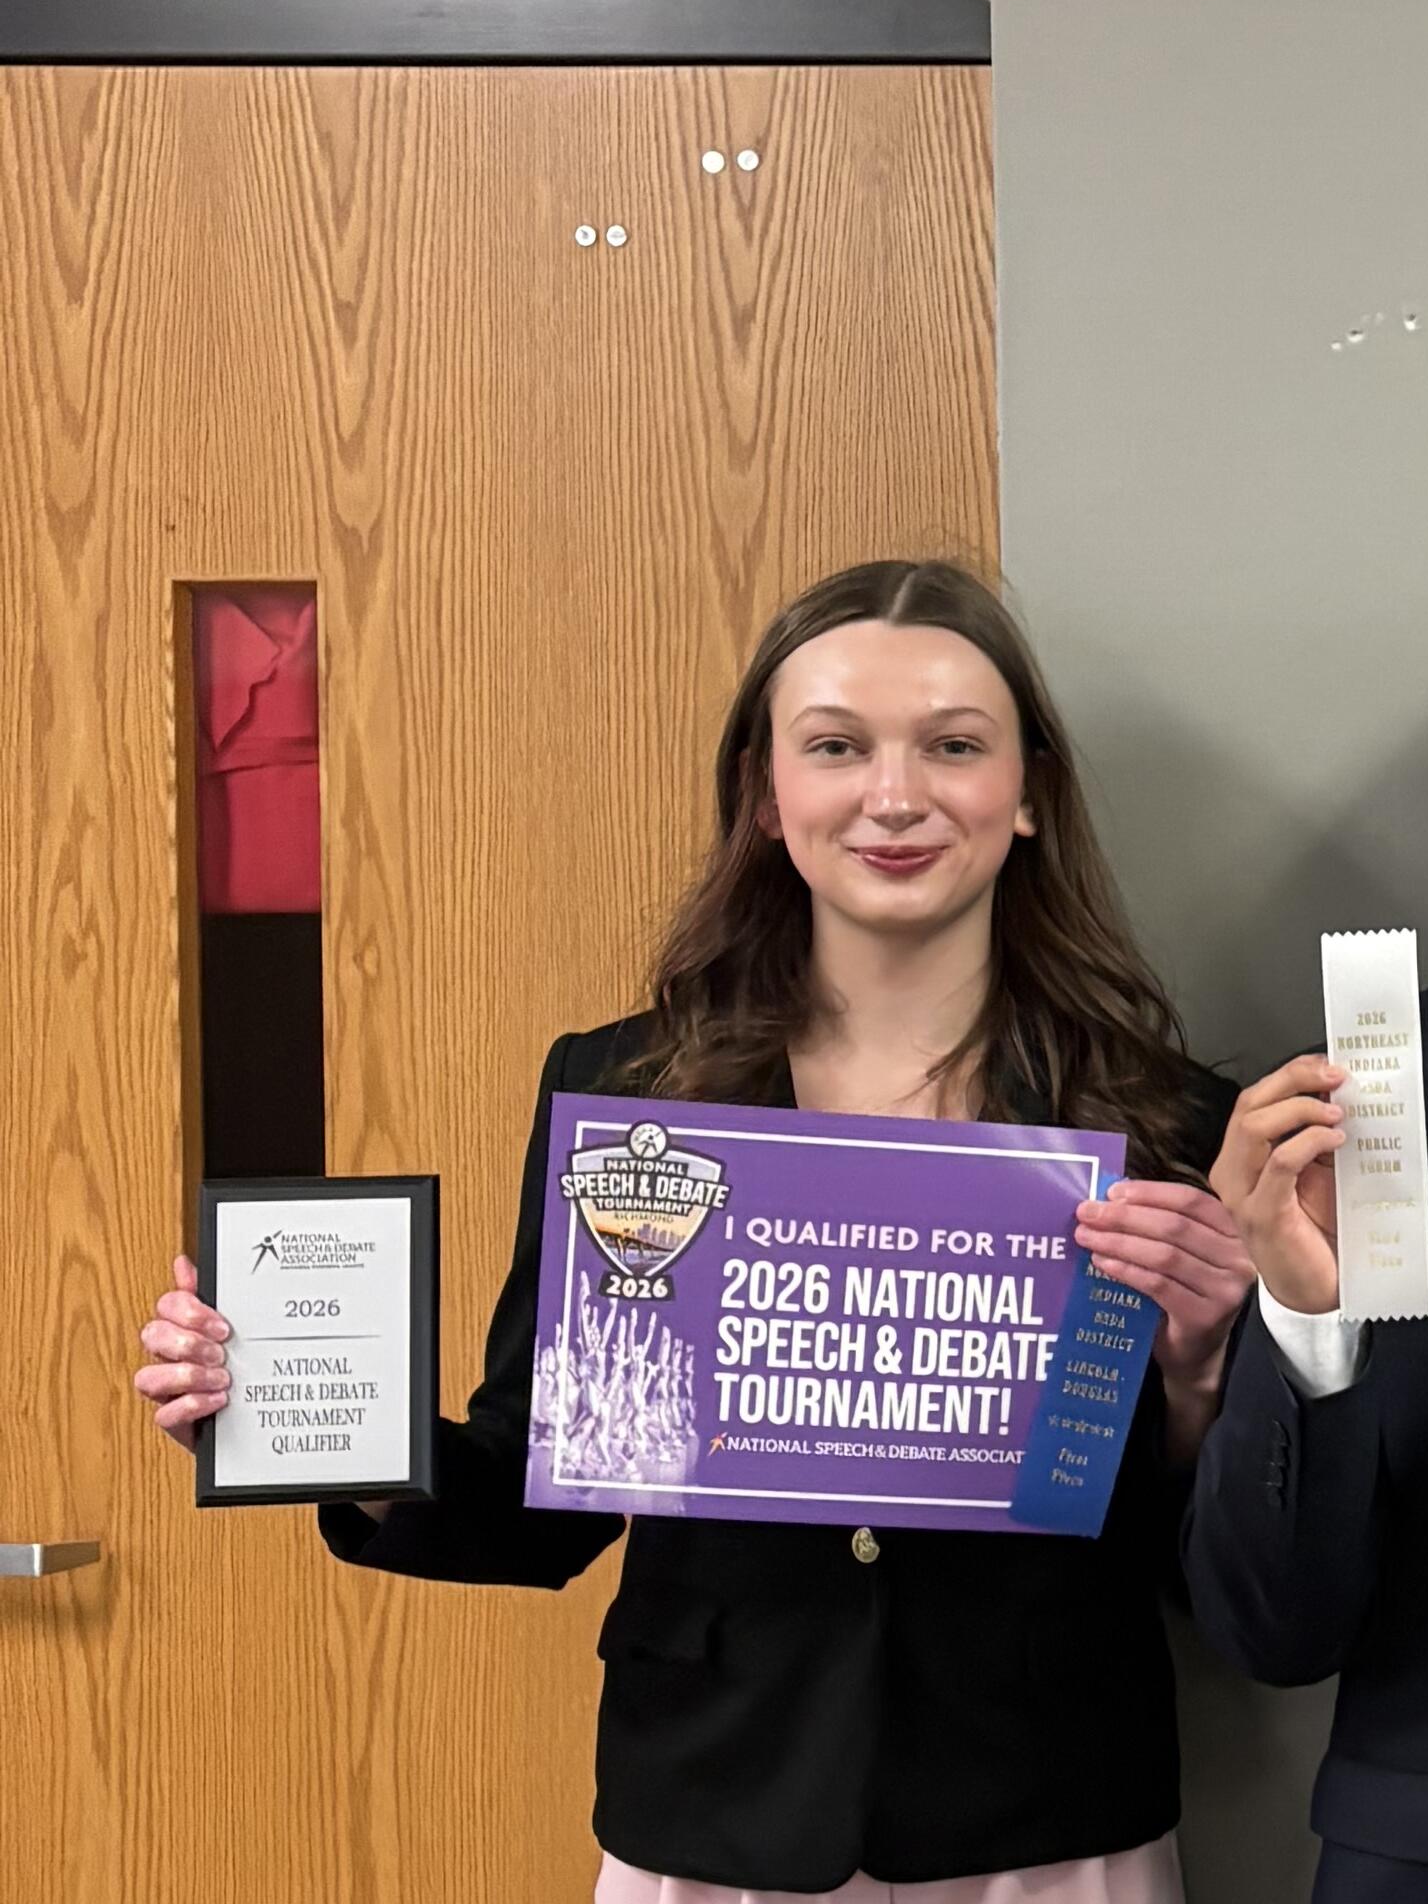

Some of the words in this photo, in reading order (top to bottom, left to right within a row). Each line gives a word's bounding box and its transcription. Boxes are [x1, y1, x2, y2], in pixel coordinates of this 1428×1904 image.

[1337, 1032, 1409, 1050] NORTHEAST
[1349, 1056, 1400, 1073] INDIANA
[1345, 1103, 1405, 1119] DISTRICT
[1356, 1137, 1403, 1151] PUBLIC
[606, 1159, 685, 1175] NATIONAL
[560, 1172, 635, 1198] SPEECH
[638, 1174, 651, 1198] &
[655, 1176, 730, 1208] DEBATE
[596, 1198, 693, 1216] TOURNAMENT
[281, 1233, 341, 1244] NATIONAL
[724, 1215, 734, 1240] I
[746, 1217, 919, 1252] QUALIFIED
[930, 1229, 995, 1256] FOR
[1006, 1233, 1067, 1260] THE
[280, 1253, 357, 1265] ASSOCIATION
[606, 1275, 668, 1298] 2026
[721, 1258, 831, 1314] 2026
[843, 1266, 1044, 1326] NATIONAL
[285, 1299, 341, 1318] 2026
[715, 1315, 867, 1373] SPEECH
[873, 1325, 904, 1376] &
[911, 1327, 1059, 1382] DEBATE
[1076, 1328, 1135, 1352] DISTRICT
[272, 1357, 353, 1377] NATIONAL
[245, 1383, 301, 1403] SPEECH
[304, 1384, 315, 1401] &
[319, 1382, 379, 1401] DEBATE
[714, 1372, 1013, 1436] TOURNAMENT!
[258, 1408, 366, 1428] TOURNAMENT
[271, 1434, 352, 1455] QUALIFIER
[727, 1436, 812, 1456] NATIONAL
[948, 1448, 1026, 1465] ASSOCIAT
